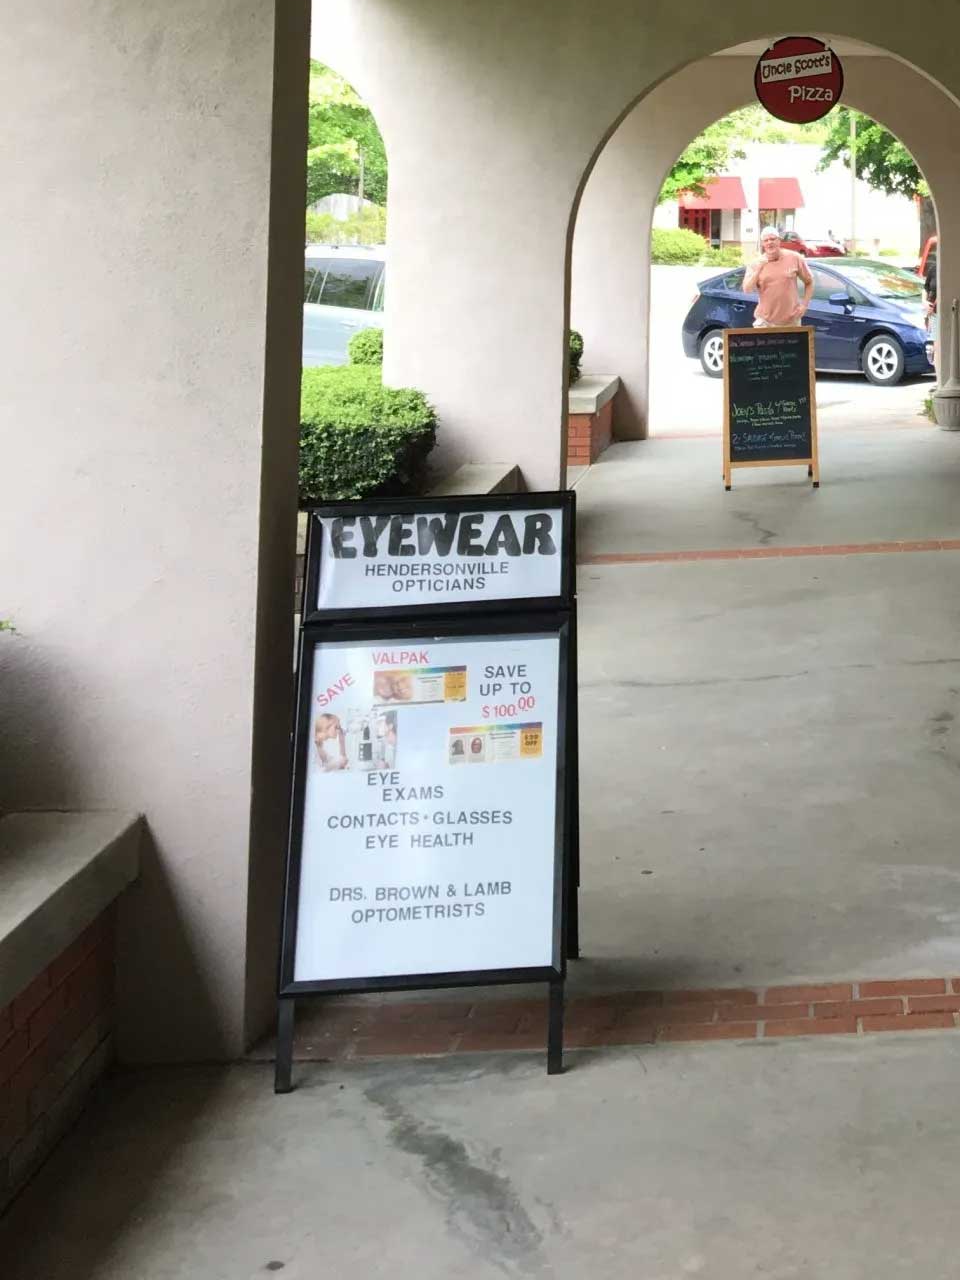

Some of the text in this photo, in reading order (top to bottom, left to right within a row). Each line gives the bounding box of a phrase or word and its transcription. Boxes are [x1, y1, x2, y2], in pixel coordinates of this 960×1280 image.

[763, 54, 830, 79] Uncle Scott's
[788, 85, 833, 104] Pizza
[330, 513, 557, 559] EYEWEAR
[365, 561, 509, 577] HENDERSONVILLE
[392, 577, 486, 593] OPTICIANS
[372, 651, 430, 665] VALPAK
[484, 664, 527, 679] SAVE
[316, 672, 355, 708] SAVE
[480, 681, 532, 696] UP TO
[367, 771, 400, 786] EYE
[382, 785, 444, 801] EXAMS
[327, 810, 513, 829] CONTACTS GLASSES
[365, 832, 473, 849] EYE HEALTH
[329, 881, 512, 901] DRS. BROWN & LAMB
[351, 902, 485, 923] OPTOMETRISTS
